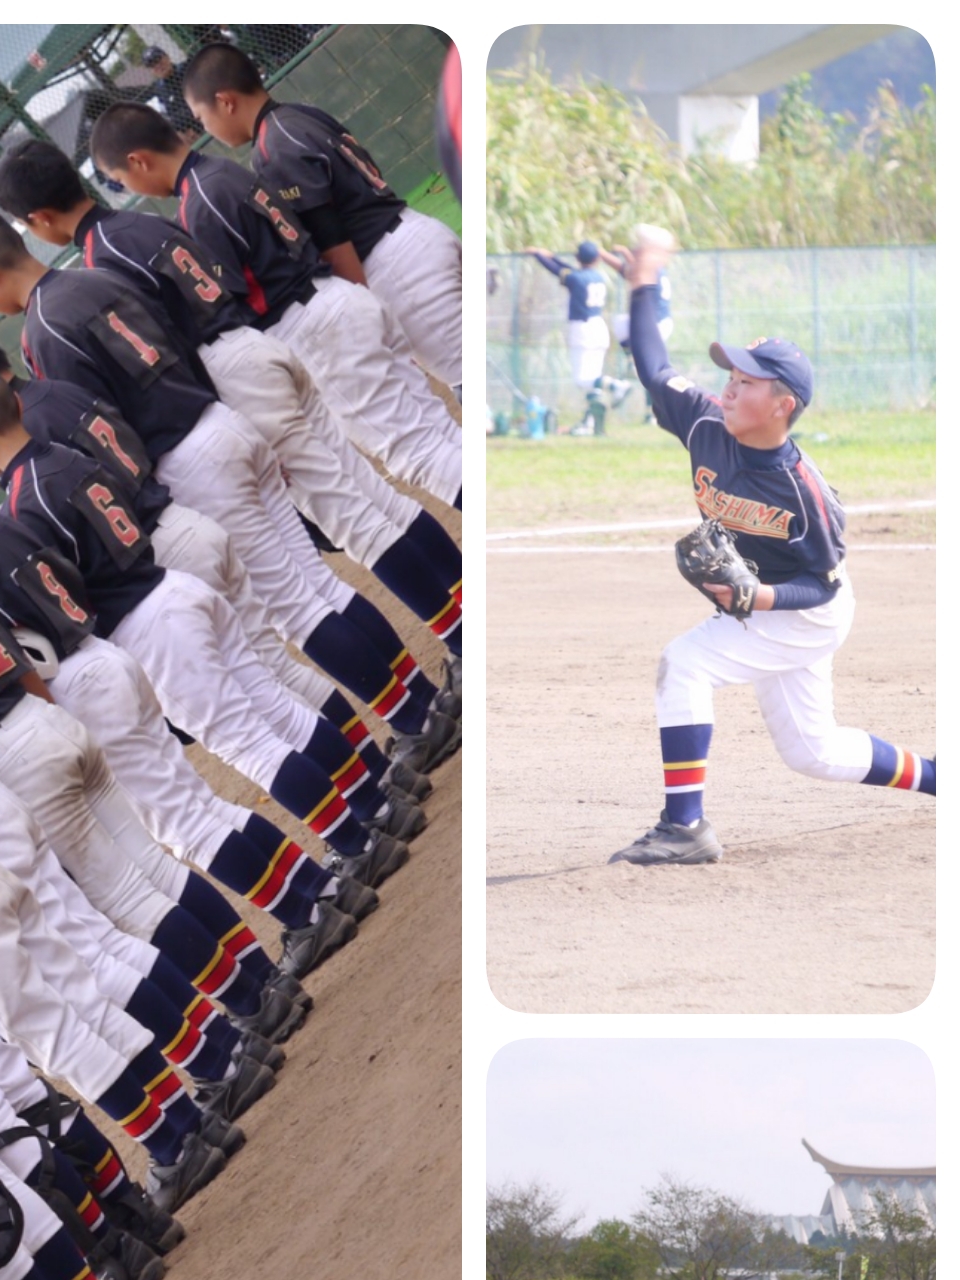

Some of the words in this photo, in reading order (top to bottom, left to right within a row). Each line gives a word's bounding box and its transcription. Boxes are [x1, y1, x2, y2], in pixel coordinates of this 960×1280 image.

[254, 188, 298, 241] 5
[171, 245, 222, 302] 3
[107, 311, 160, 367] 1
[88, 415, 139, 477] 7
[86, 482, 140, 548] 6
[36, 561, 88, 625] 8
